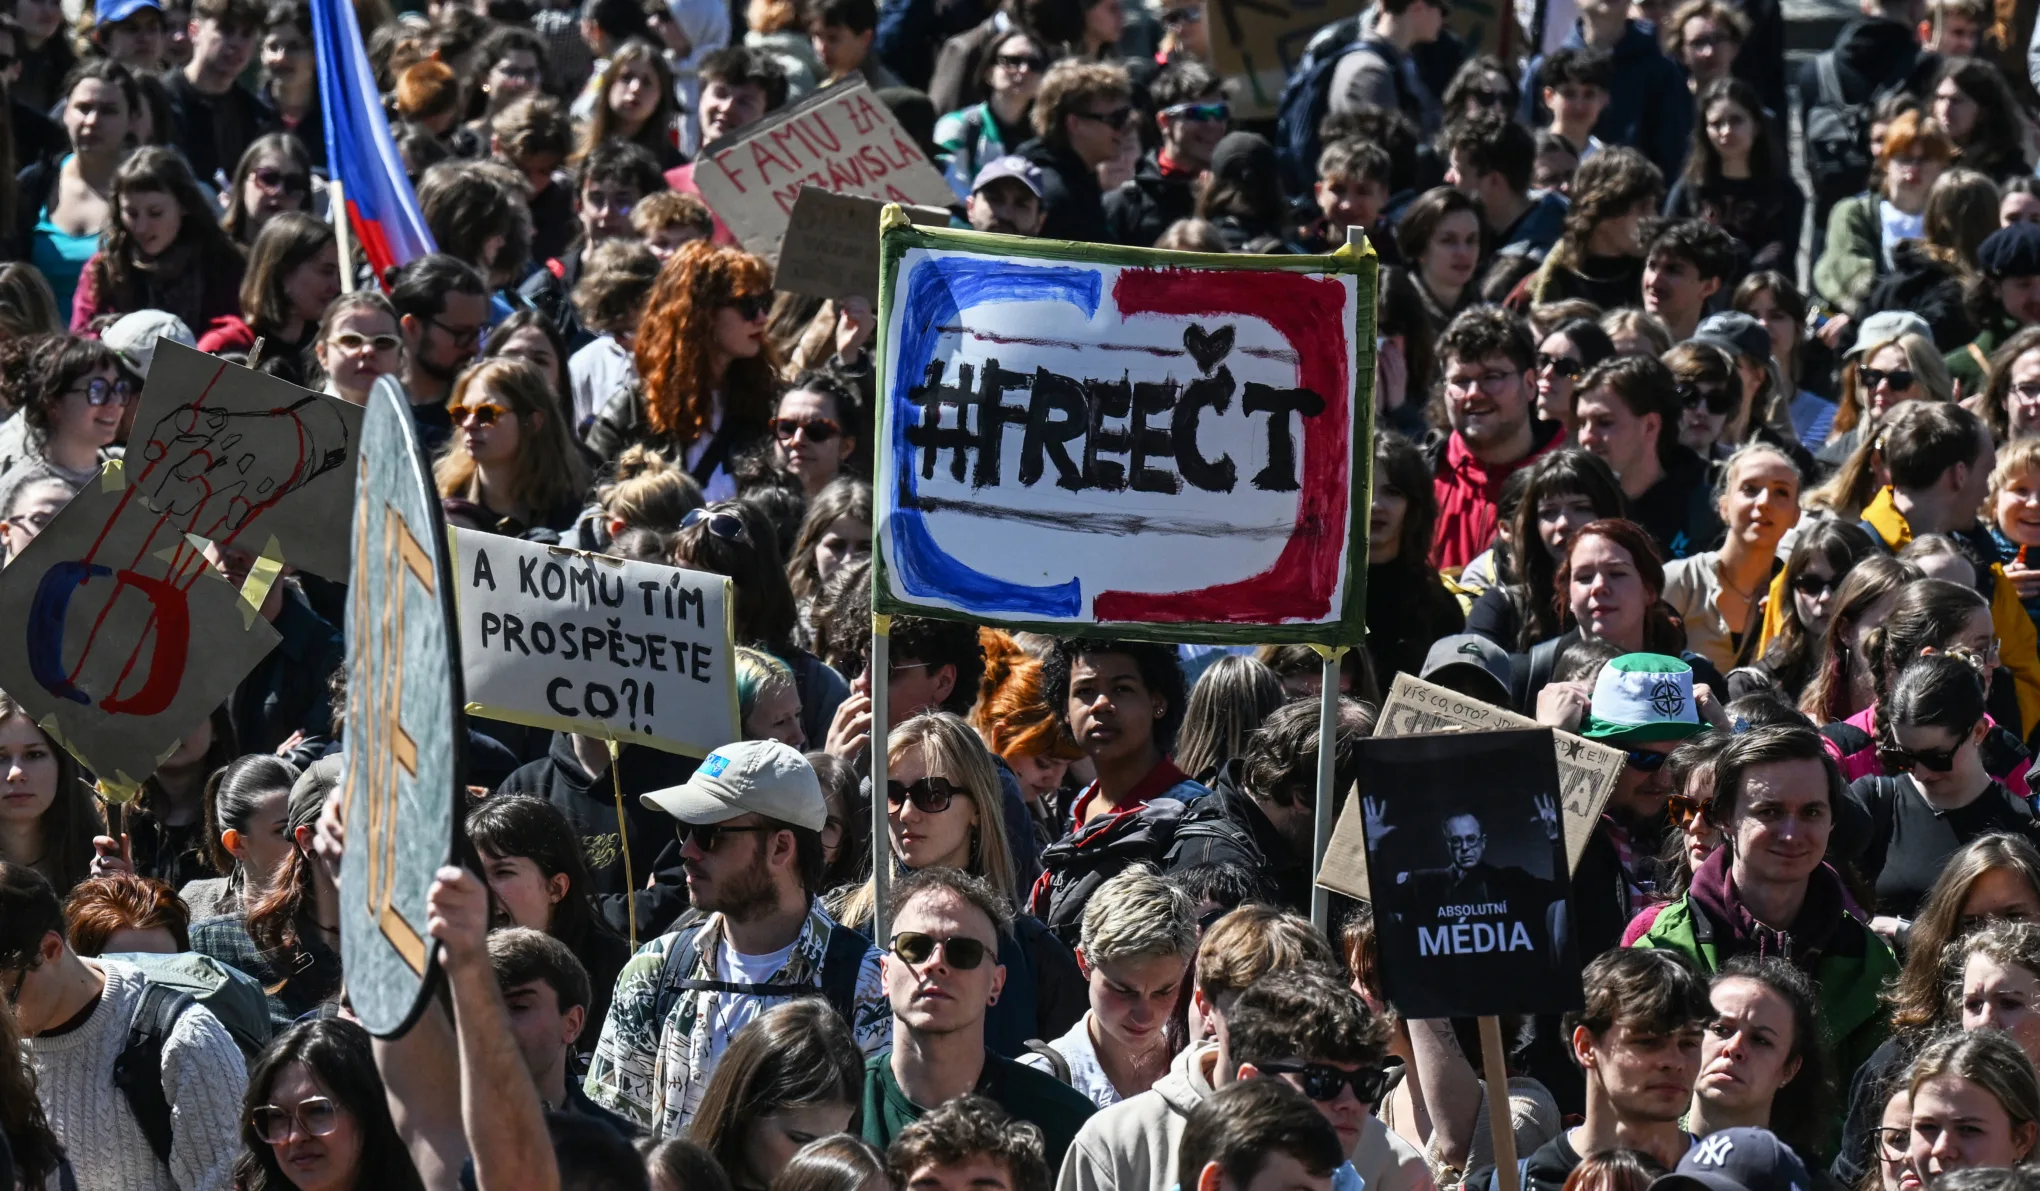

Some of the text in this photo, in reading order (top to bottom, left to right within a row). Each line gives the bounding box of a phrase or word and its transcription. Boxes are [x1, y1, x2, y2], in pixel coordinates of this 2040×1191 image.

[715, 95, 887, 193] FAMU ZA
[772, 127, 923, 217] NZÁVISLÁ
[906, 322, 1326, 495] #FREEČT
[473, 548, 706, 629] A KOMU TÍM
[481, 611, 713, 684] PROSPĚJETE
[546, 676, 655, 735] CO?!
[1402, 684, 1431, 702] VÍŠ
[1431, 695, 1448, 713] CO,
[1453, 703, 1490, 723] OTO?
[1417, 916, 1535, 957] MÉDIA
[1437, 900, 1508, 918] ABSOLUTNÍ
[1693, 1134, 1734, 1167] NY
